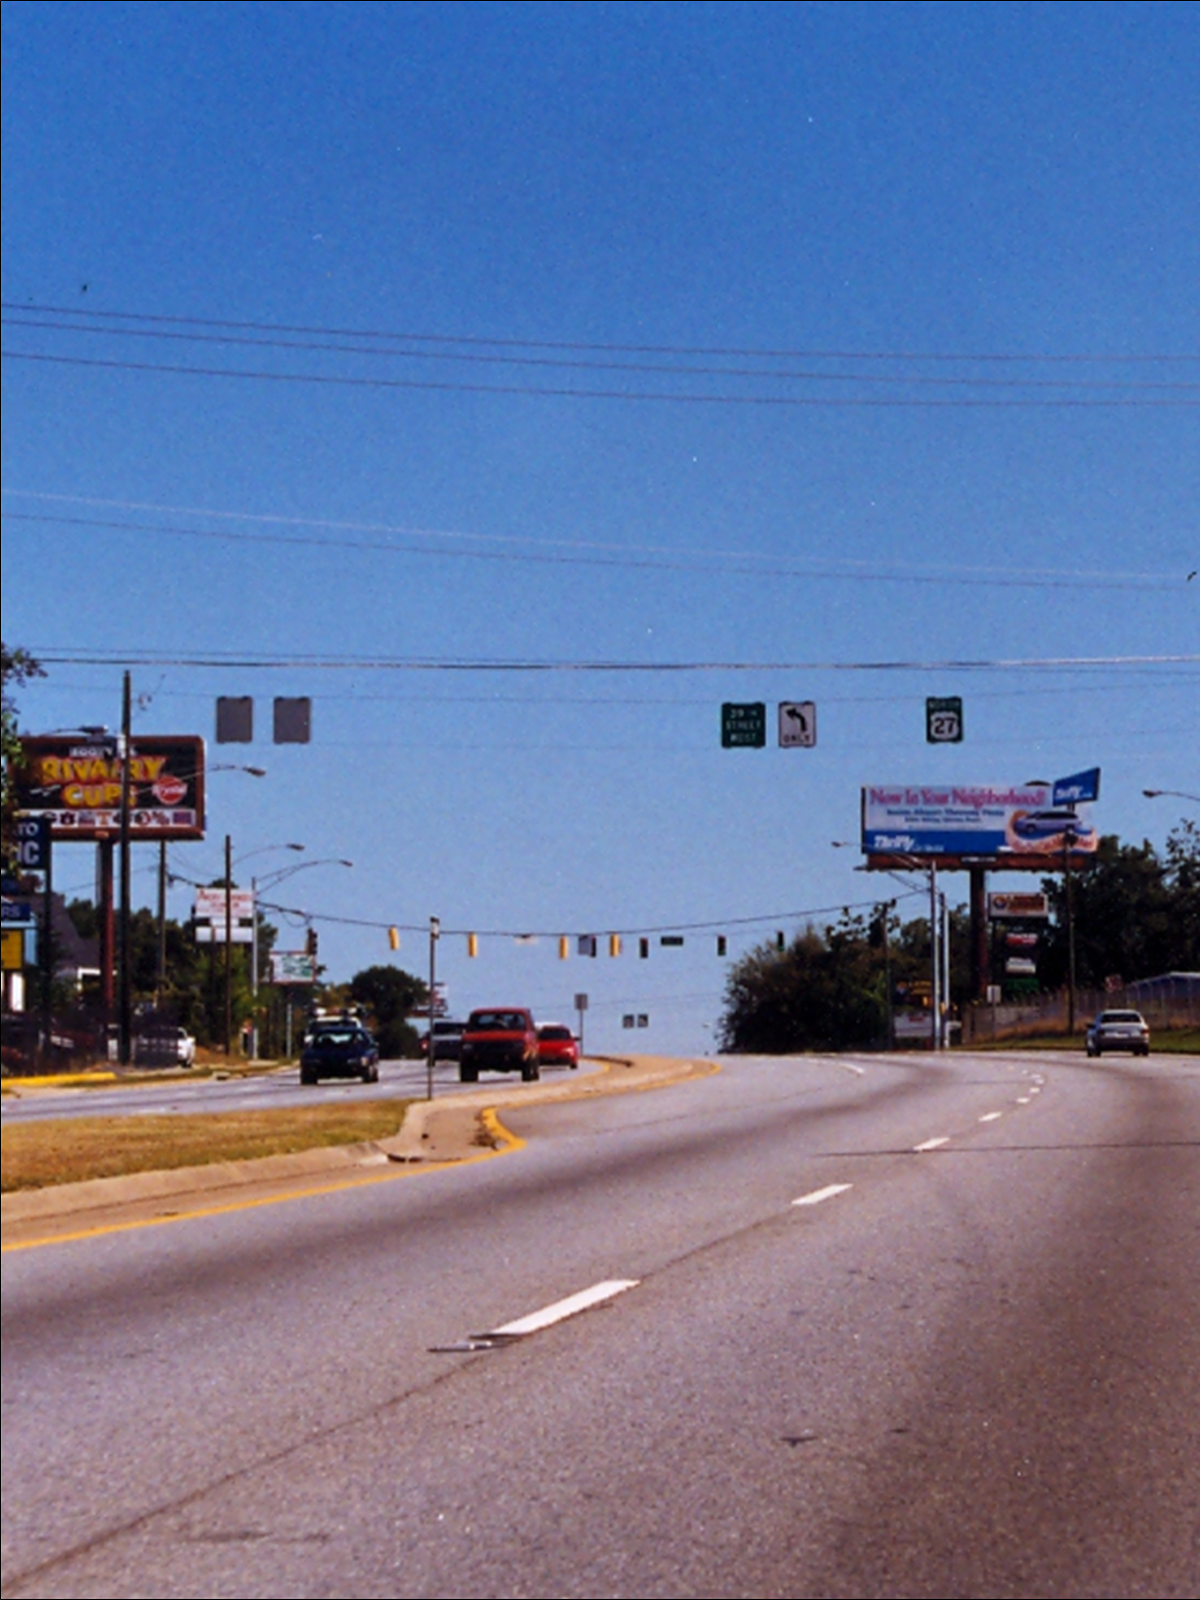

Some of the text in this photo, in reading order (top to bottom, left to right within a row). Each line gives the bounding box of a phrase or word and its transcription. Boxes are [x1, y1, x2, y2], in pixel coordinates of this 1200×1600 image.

[934, 716, 956, 735] 27
[783, 734, 810, 743] ONLY
[870, 788, 902, 805] Now
[905, 788, 919, 805] In
[921, 788, 949, 805] Your
